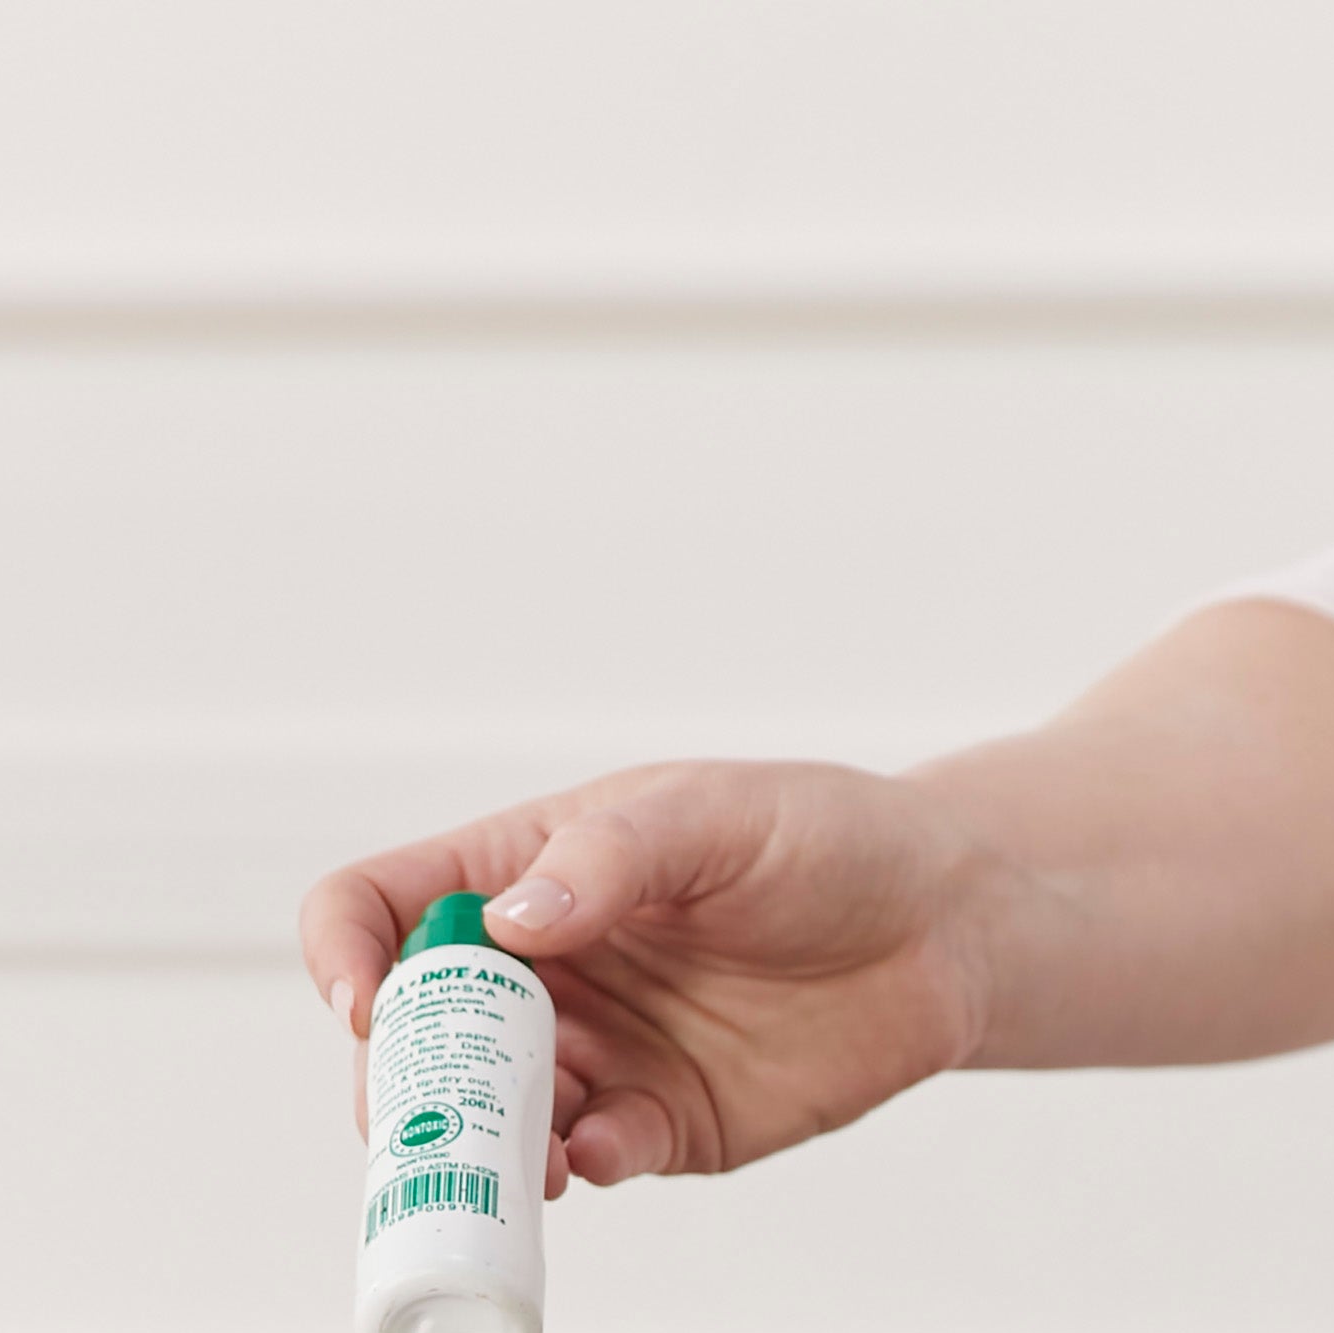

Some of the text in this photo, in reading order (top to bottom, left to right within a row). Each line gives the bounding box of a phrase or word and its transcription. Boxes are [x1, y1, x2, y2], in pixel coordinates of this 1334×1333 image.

[455, 1031, 497, 1044] paper
[458, 1096, 506, 1118] 20614
[402, 1118, 450, 1141] NONTOXIC
[427, 1162, 459, 1171] ASTM
